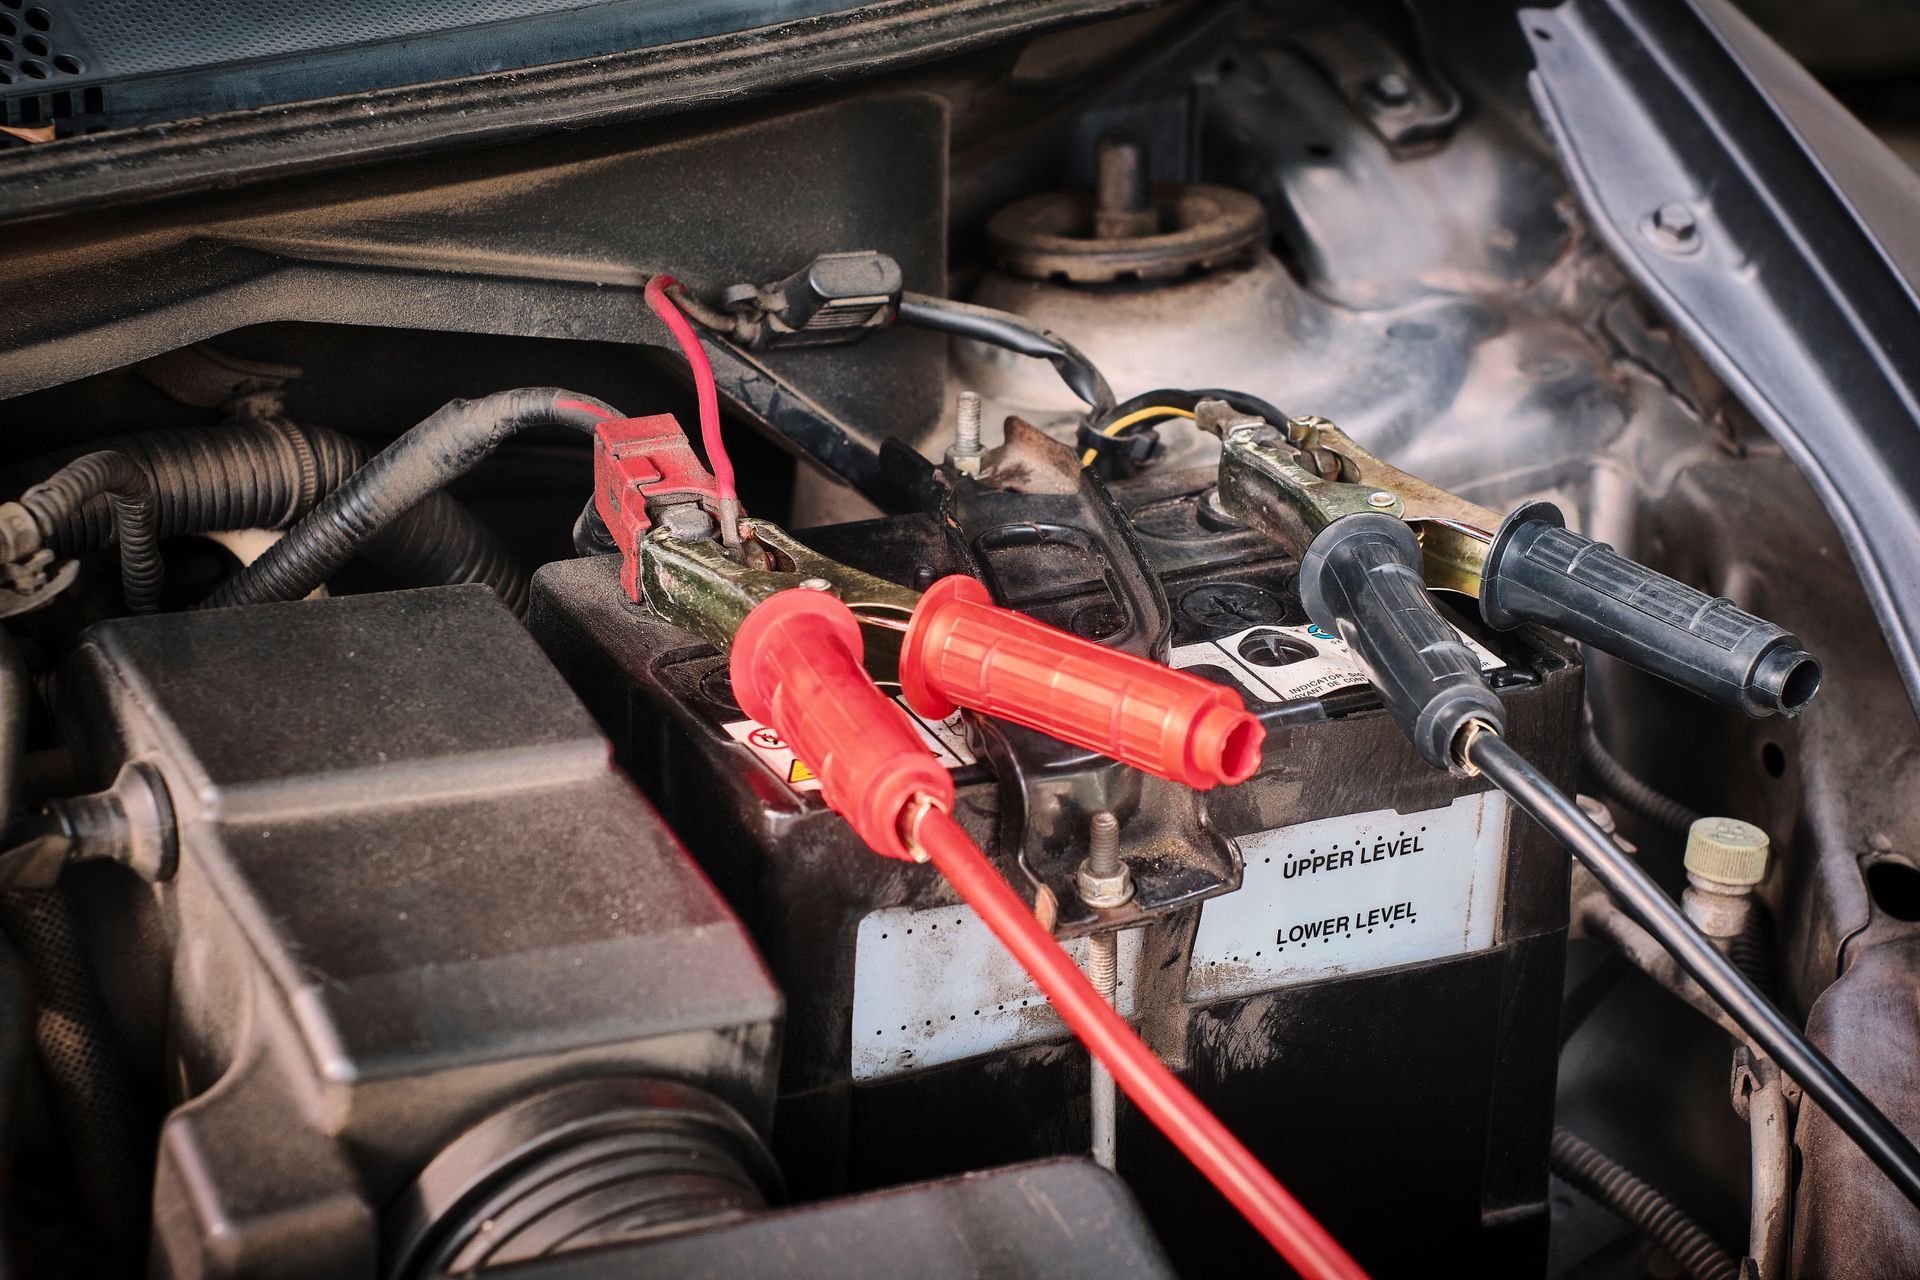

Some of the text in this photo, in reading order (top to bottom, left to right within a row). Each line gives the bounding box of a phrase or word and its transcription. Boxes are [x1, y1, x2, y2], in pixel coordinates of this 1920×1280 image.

[1287, 686, 1324, 700] VOYANT
[1327, 680, 1341, 688] DE
[1289, 673, 1345, 695] INDICATOR
[1283, 836, 1424, 879] UPPER LEVEL
[1276, 902, 1417, 945] LOWER LEVEL
